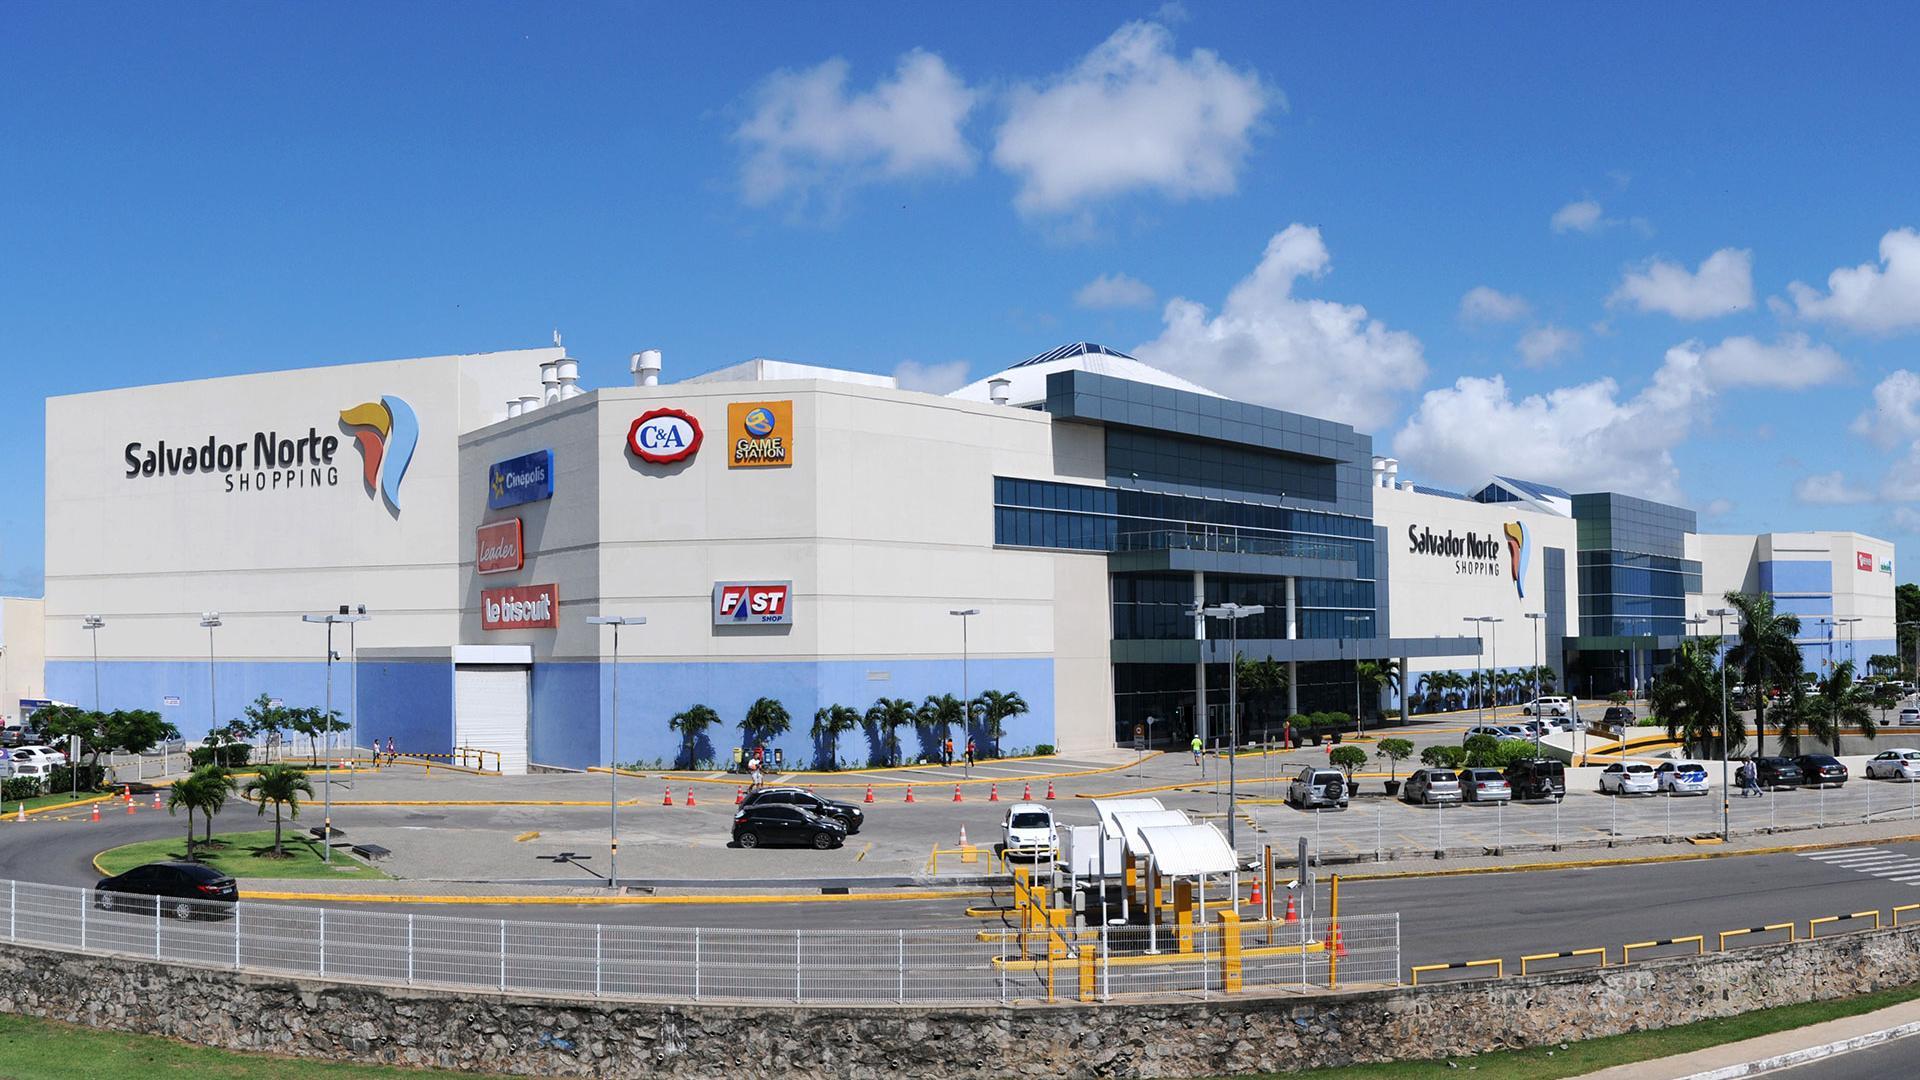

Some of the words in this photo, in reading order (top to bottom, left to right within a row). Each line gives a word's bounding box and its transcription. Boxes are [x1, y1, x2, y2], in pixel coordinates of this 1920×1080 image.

[640, 424, 685, 449] C&A
[737, 438, 782, 451] GAME
[125, 435, 248, 478] Salvador
[254, 427, 339, 469] Norte
[735, 448, 785, 459] STATION
[225, 467, 338, 493] SHOPPING
[506, 466, 545, 489] Cinépolis
[1408, 523, 1466, 558] Salvador
[1466, 531, 1500, 561] Norte
[1455, 560, 1500, 577] SHOPPING
[501, 593, 551, 622] biscuit
[721, 587, 784, 621] FAST
